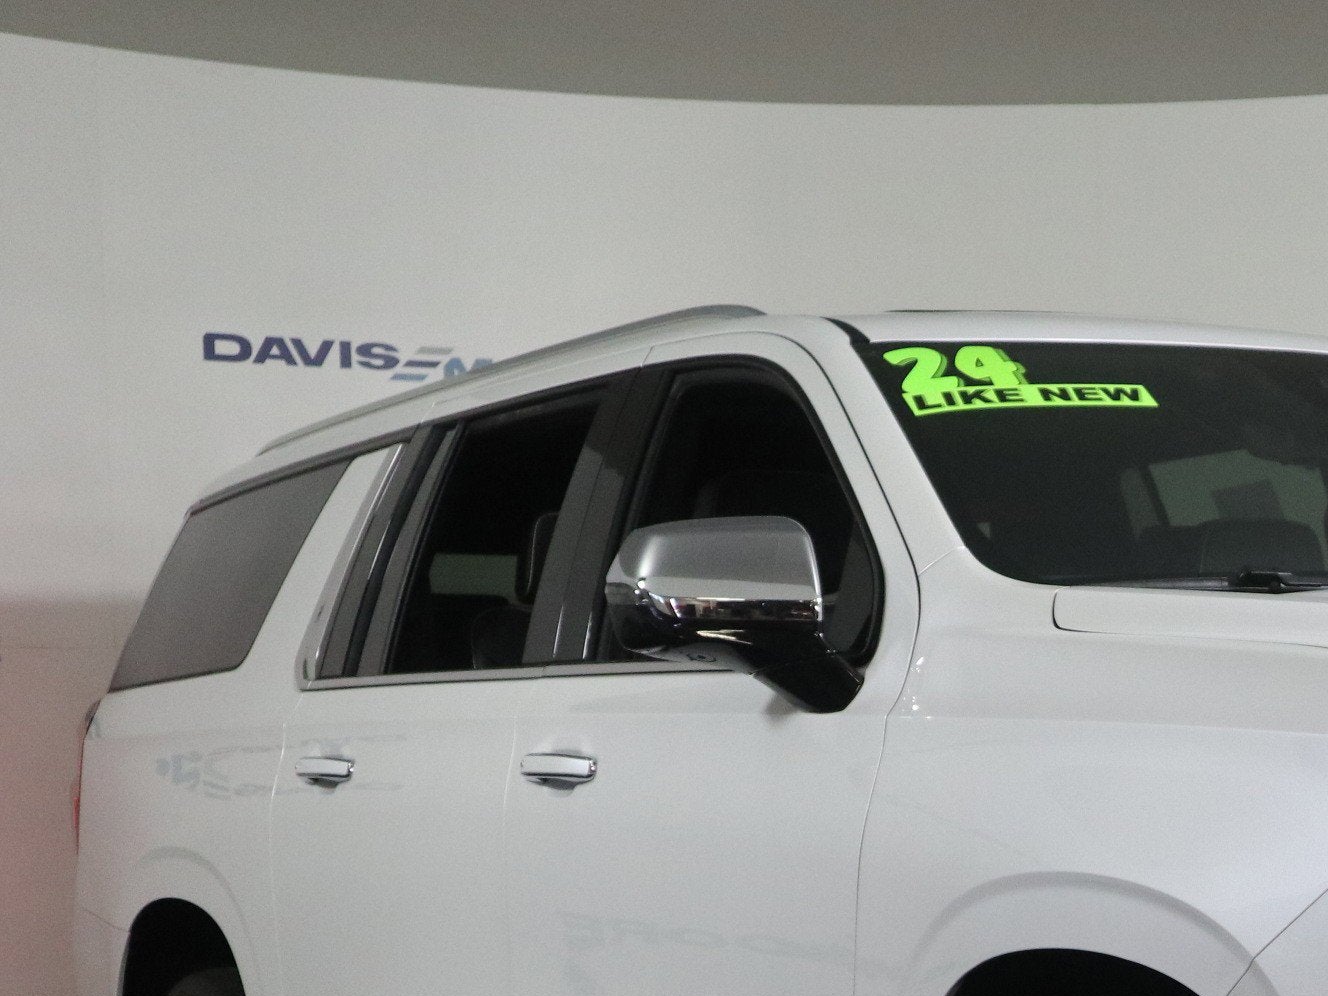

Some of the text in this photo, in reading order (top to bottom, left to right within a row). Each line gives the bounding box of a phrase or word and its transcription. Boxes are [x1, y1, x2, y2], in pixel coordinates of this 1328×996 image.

[202, 332, 400, 370] DAVIS
[883, 345, 1026, 392] 24
[912, 387, 1141, 410] LIKE NEW
